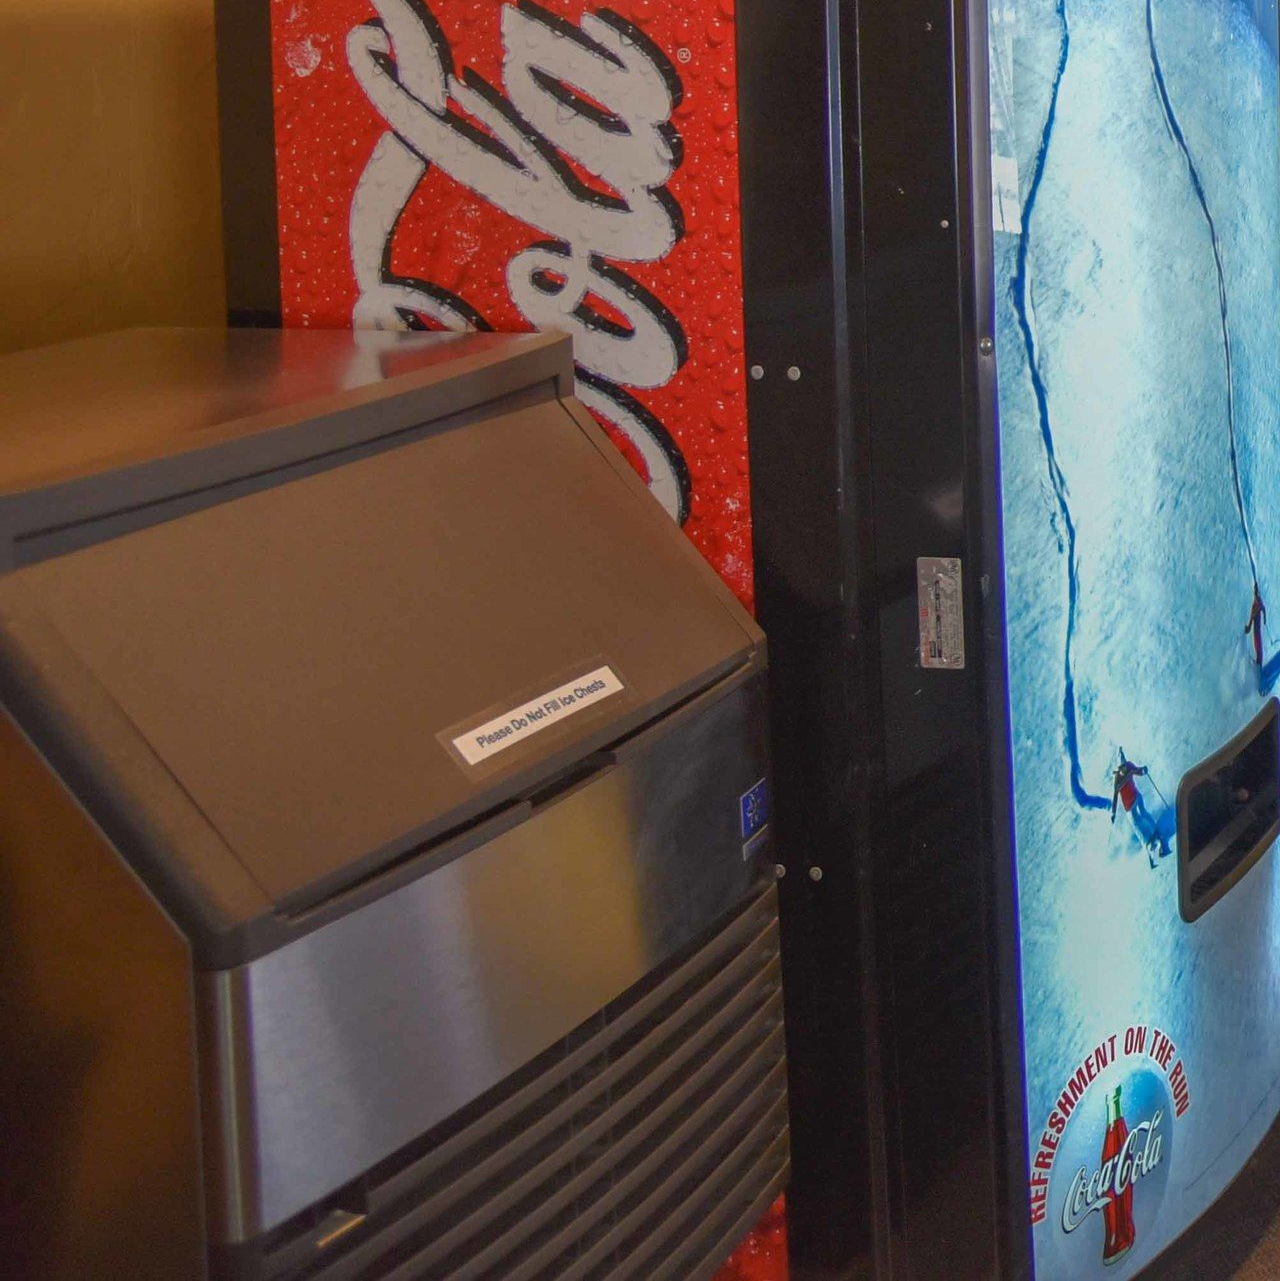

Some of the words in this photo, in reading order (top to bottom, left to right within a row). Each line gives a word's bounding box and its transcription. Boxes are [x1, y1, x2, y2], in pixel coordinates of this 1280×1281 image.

[476, 724, 513, 748] Please
[510, 717, 528, 731] Do
[525, 707, 547, 722] Not
[544, 698, 561, 714] Fill
[558, 693, 576, 707] Ice
[573, 678, 606, 699] Chests
[1029, 1034, 1117, 1224] REFRESHMENT
[1123, 1026, 1147, 1056] ON
[1149, 1029, 1176, 1071] THE
[1168, 1060, 1190, 1118] RUN
[1061, 1109, 1164, 1234] Coca-Cola
